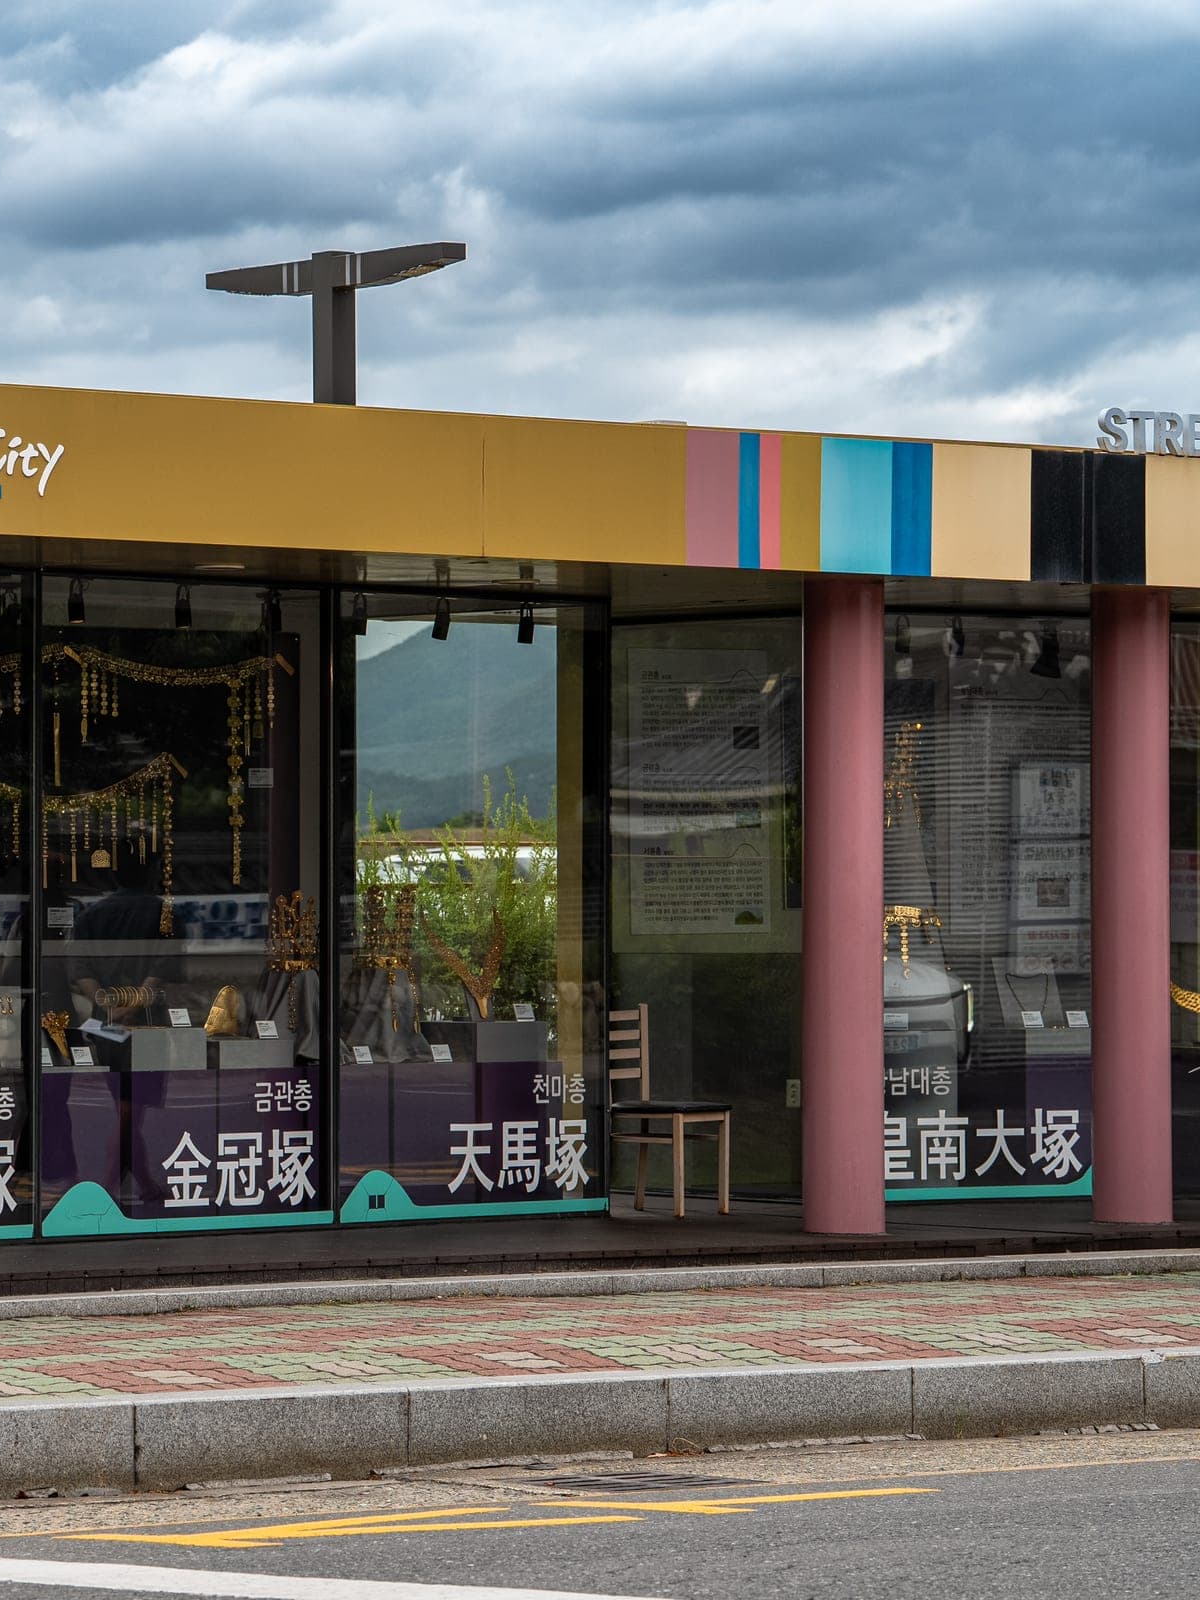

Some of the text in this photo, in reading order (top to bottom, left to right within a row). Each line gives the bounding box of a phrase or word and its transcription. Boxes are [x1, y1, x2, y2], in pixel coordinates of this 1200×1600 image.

[253, 1079, 313, 1112] 금관총
[532, 1073, 587, 1105] 천마총
[884, 1066, 952, 1096] 남대총
[162, 1129, 317, 1208] 金冠塚
[447, 1117, 591, 1194] 天馬塚
